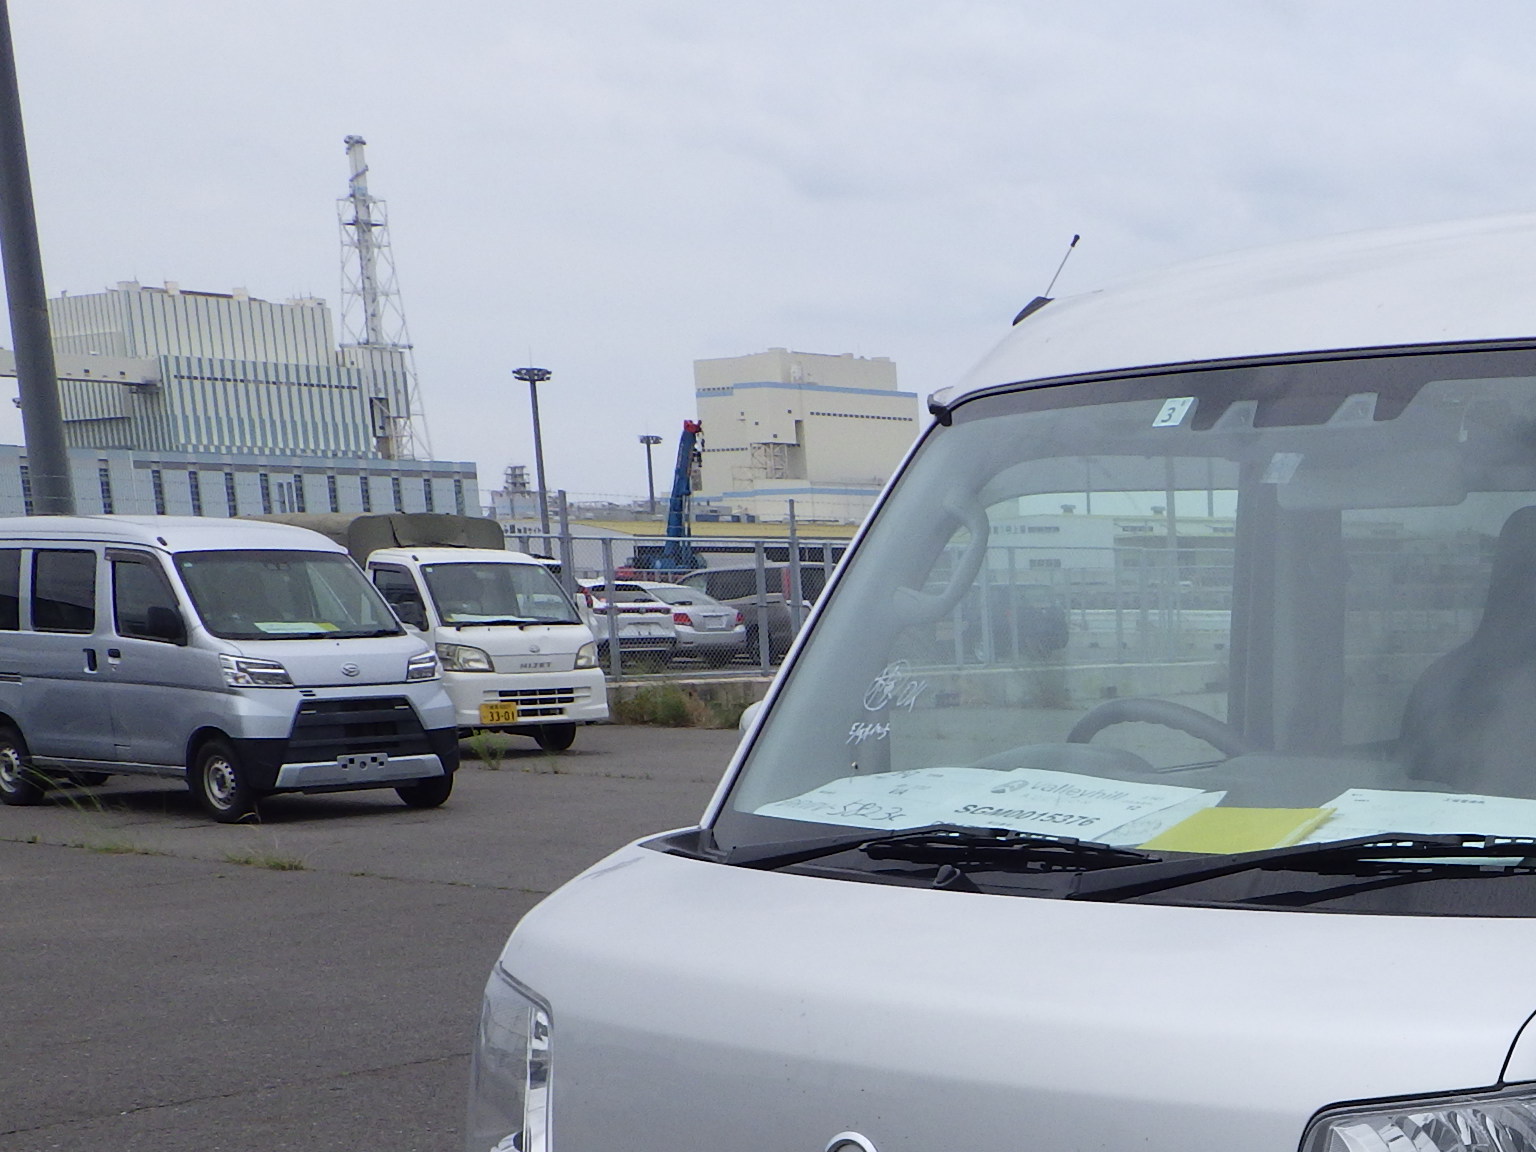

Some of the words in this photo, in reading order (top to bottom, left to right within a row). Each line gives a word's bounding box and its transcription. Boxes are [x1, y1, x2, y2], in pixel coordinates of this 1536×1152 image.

[1161, 406, 1177, 423] 3
[1030, 780, 1130, 801] valleyhill
[954, 803, 1101, 827] SGM0015376
